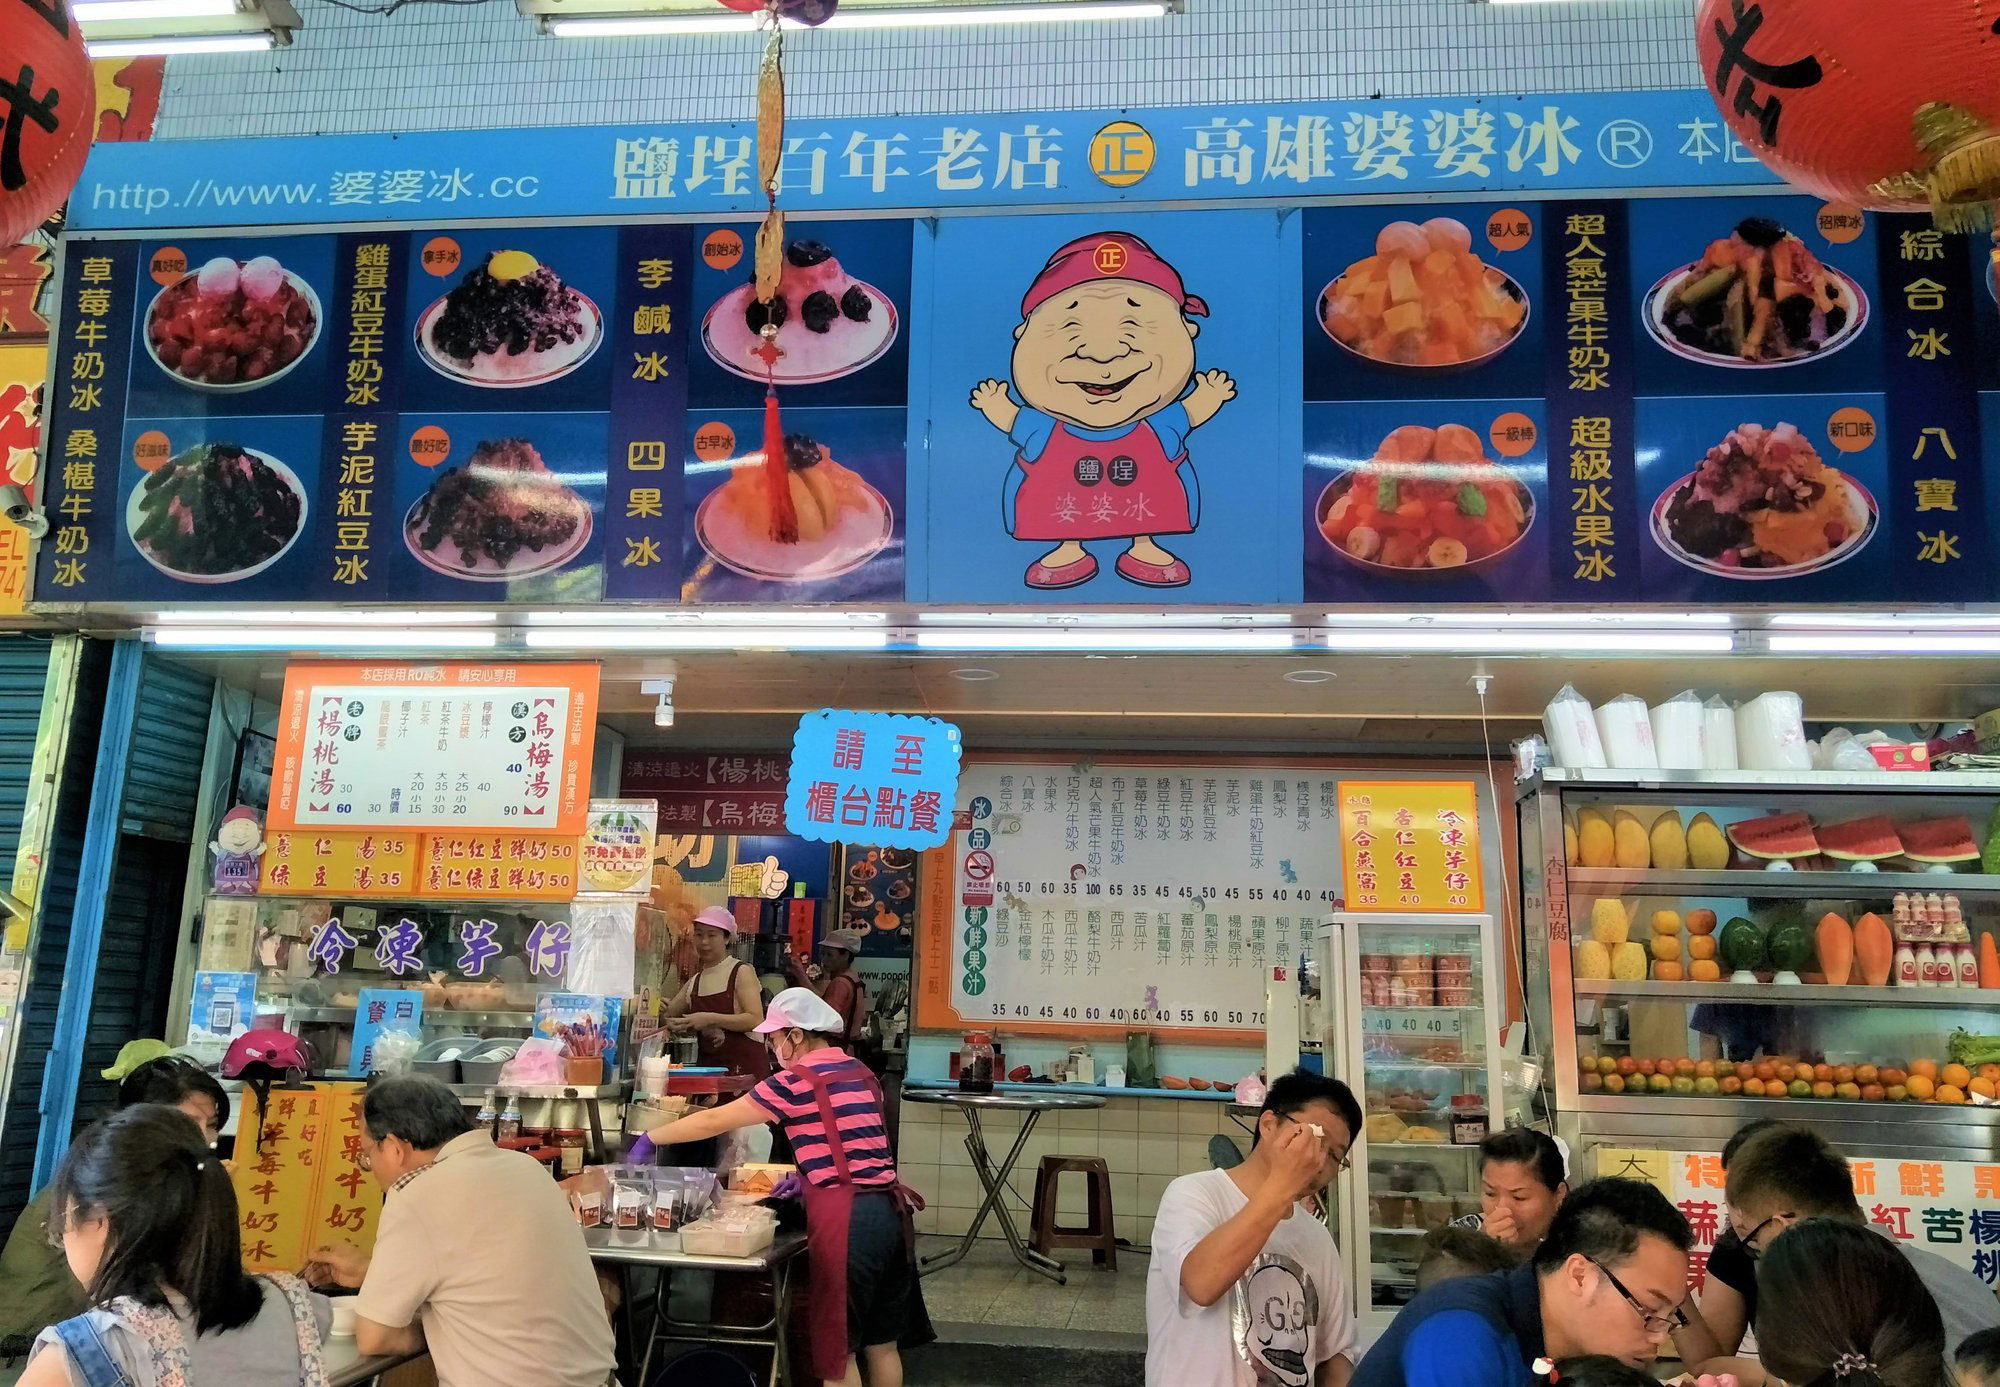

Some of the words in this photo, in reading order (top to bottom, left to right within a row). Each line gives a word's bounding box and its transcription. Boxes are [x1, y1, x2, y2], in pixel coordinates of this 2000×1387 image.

[608, 125, 1064, 200] 鹽埕百年老店
[1181, 106, 1582, 188] 高雄婆婆冰
[1488, 222, 1531, 238] 超人氣
[1820, 215, 1863, 231] 招牌冰
[422, 250, 459, 265] 拿手冰
[703, 241, 742, 258] 創始冰
[1564, 214, 1611, 392] 超人氣芒果牛奶冰
[1900, 229, 1952, 361] 綜合冰
[68, 257, 113, 412] 草莓牛奶冰
[344, 245, 391, 406] 雞蛋紅豆牛奶冰
[632, 258, 673, 382] 李鹹冰
[411, 438, 449, 455] 最好吃
[696, 434, 734, 451] 古早冰
[1491, 425, 1534, 443] 一級棒
[1829, 421, 1874, 438] 新口味
[1078, 460, 1133, 481] 鹽埕
[52, 428, 98, 588] 桑椹牛奶冰
[332, 422, 378, 586] 芋泥紅豆冰
[625, 441, 666, 567] 四果冰
[1050, 492, 1157, 524] 婆婆冰
[1569, 415, 1617, 583] 超級水果冰
[1911, 428, 1962, 564] 八寶冰
[346, 702, 363, 740] 老牌
[398, 700, 412, 739] 椰子汁
[419, 701, 431, 725] 紅茶
[437, 701, 452, 751] 紅茶牛奶
[506, 763, 522, 773] 40
[833, 728, 925, 775] 請至
[340, 784, 352, 793] 30
[411, 782, 424, 791] 20
[435, 782, 448, 791] 35
[455, 782, 469, 791] 25
[477, 782, 491, 791] 40
[389, 788, 401, 814] 時價
[806, 780, 942, 834] 櫃台點餐
[1000, 775, 1014, 812] 綜合冰
[1021, 775, 1035, 812] 八寶冰
[1043, 776, 1057, 813] 水果冰
[1226, 780, 1240, 817] 芋泥冰
[1272, 780, 1287, 819] 鳳梨冰
[1320, 781, 1335, 820] 楊桃冰
[336, 804, 352, 813] 60
[367, 804, 381, 813] 30
[408, 804, 422, 814] 15
[432, 804, 445, 814] 30
[453, 804, 467, 814] 20
[503, 805, 518, 815] 90
[1065, 776, 1080, 852] 巧克力牛奶冰
[1087, 777, 1103, 878] 超人氣芒果牛奶冰
[1110, 777, 1125, 866] 布丁紅豆牛奶冰
[1134, 778, 1148, 841] 草莓牛奶冰
[1156, 778, 1171, 841] 綠豆牛奶冰
[1179, 778, 1194, 842] 紅豆牛奶冰
[1202, 779, 1217, 842] 芋泥紅豆冰
[1249, 780, 1264, 870] 雞蛋牛奶紅豆冰
[384, 840, 403, 853] 35
[551, 845, 572, 857] 50
[1351, 810, 1378, 890] 百合燕窩
[1437, 810, 1469, 890] 冷凍芋仔
[380, 872, 400, 885] 35
[549, 875, 570, 887] 50
[997, 881, 1010, 893] 60
[1017, 881, 1031, 893] 50
[1041, 882, 1055, 893] 60
[1063, 882, 1077, 894] 35
[1086, 883, 1101, 895] 100
[1109, 884, 1123, 895] 65
[1132, 885, 1146, 896] 35
[1155, 886, 1169, 897] 45
[1179, 886, 1193, 898] 45
[1202, 887, 1216, 899] 50
[1225, 888, 1239, 899] 45
[1249, 888, 1263, 900] 55
[1273, 889, 1287, 901] 40
[1296, 890, 1311, 901] 40
[1320, 890, 1335, 902] 40
[1359, 895, 1378, 904] 35
[1399, 895, 1420, 904] 40
[1449, 895, 1467, 905] 40
[1546, 856, 1567, 941] 杏仁豆腐
[307, 917, 572, 978] 冷凍芋仔
[995, 908, 1009, 948] 綠豆沙
[1040, 909, 1055, 976] 木瓜牛奶汁
[1063, 910, 1078, 976] 西瓜牛奶汁
[1087, 910, 1101, 977] 酪梨牛奶汁
[1110, 911, 1124, 951] 西瓜汁
[1133, 912, 1148, 952] 苦瓜汁
[1157, 912, 1171, 966] 紅蘿蔔汁
[1204, 914, 1218, 967] 鳳梨原汁
[1228, 914, 1242, 968] 楊桃原汁
[1252, 916, 1266, 969] 蘋果原汁
[966, 905, 983, 995] 新鮮果汁
[992, 1003, 1006, 1016] 35
[1015, 1005, 1029, 1016] 40
[1039, 1006, 1053, 1018] 45
[1063, 1007, 1077, 1019] 40
[1086, 1008, 1100, 1019] 60
[1109, 1008, 1124, 1020] 40
[1133, 1009, 1147, 1021] 60
[1156, 1010, 1170, 1021] 40
[1180, 1010, 1194, 1022] 55
[1204, 1011, 1218, 1022] 60
[1228, 1011, 1242, 1023] 50
[1252, 1012, 1265, 1024] 70
[1376, 1018, 1391, 1030] 40
[1402, 1018, 1417, 1031] 40
[1426, 1020, 1442, 1032] 40
